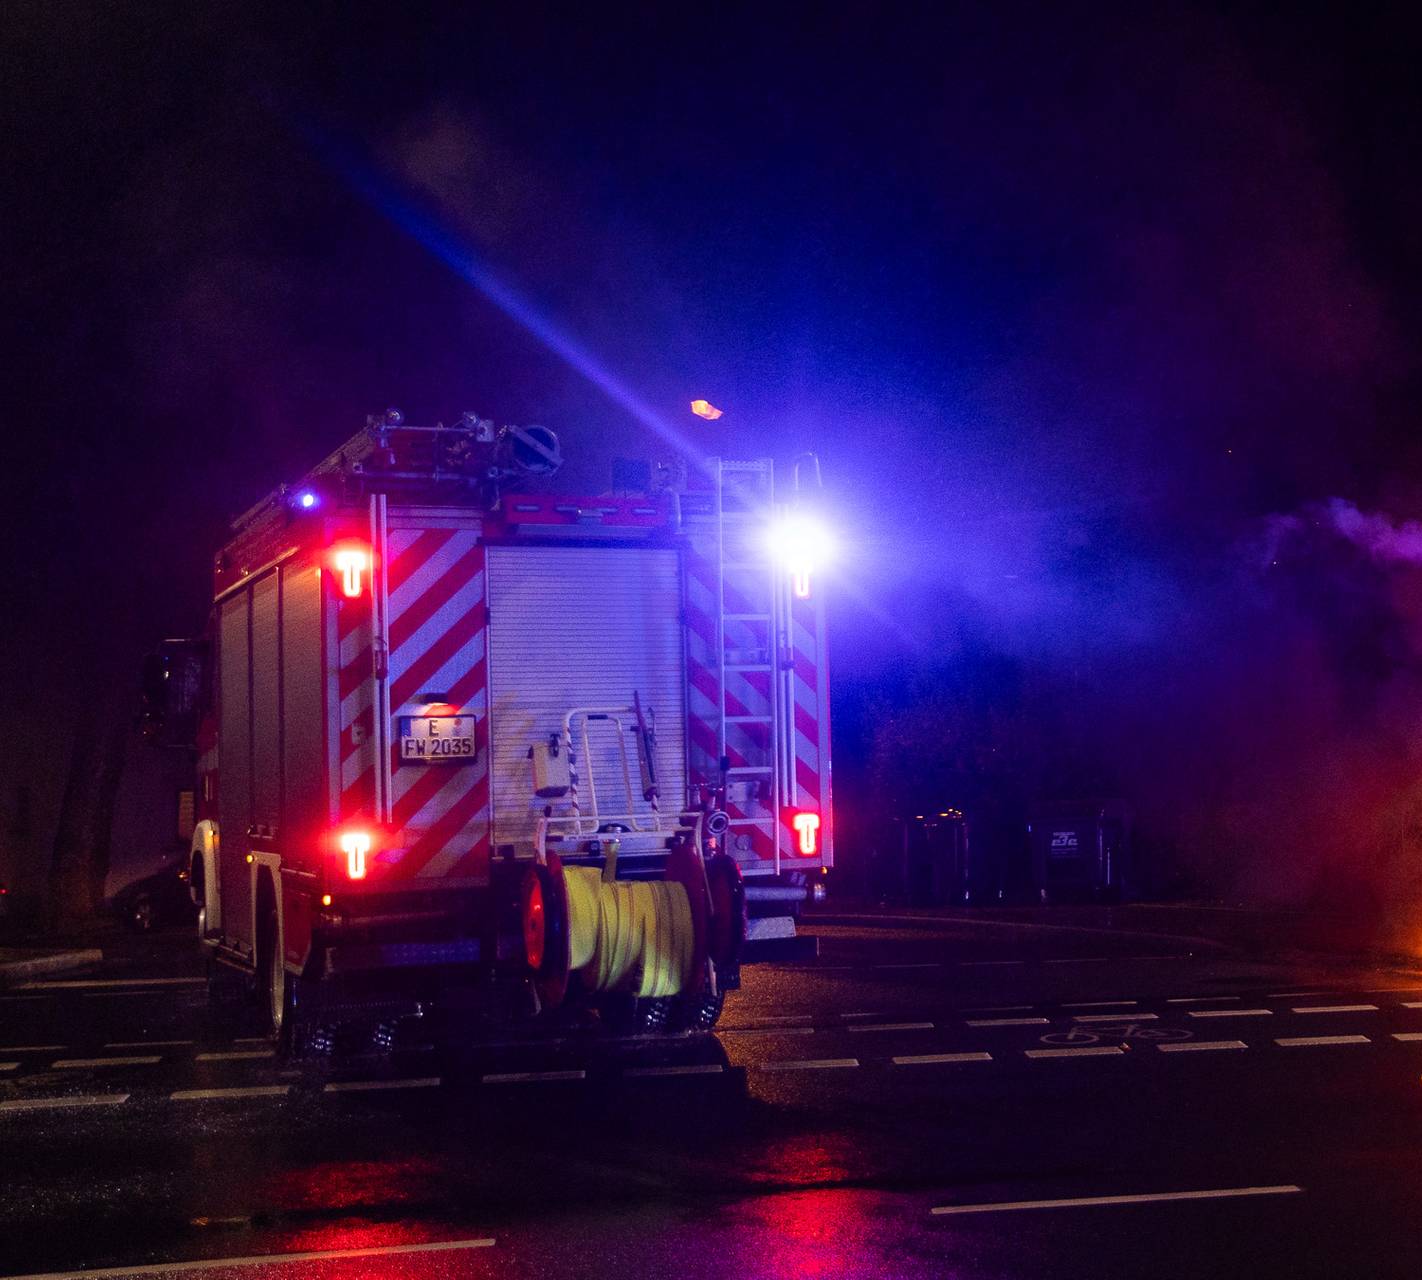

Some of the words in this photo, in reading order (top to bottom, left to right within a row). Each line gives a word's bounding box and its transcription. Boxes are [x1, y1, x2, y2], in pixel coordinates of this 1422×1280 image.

[429, 720, 439, 736] E
[405, 740, 426, 755] FW
[431, 738, 471, 755] 2035
